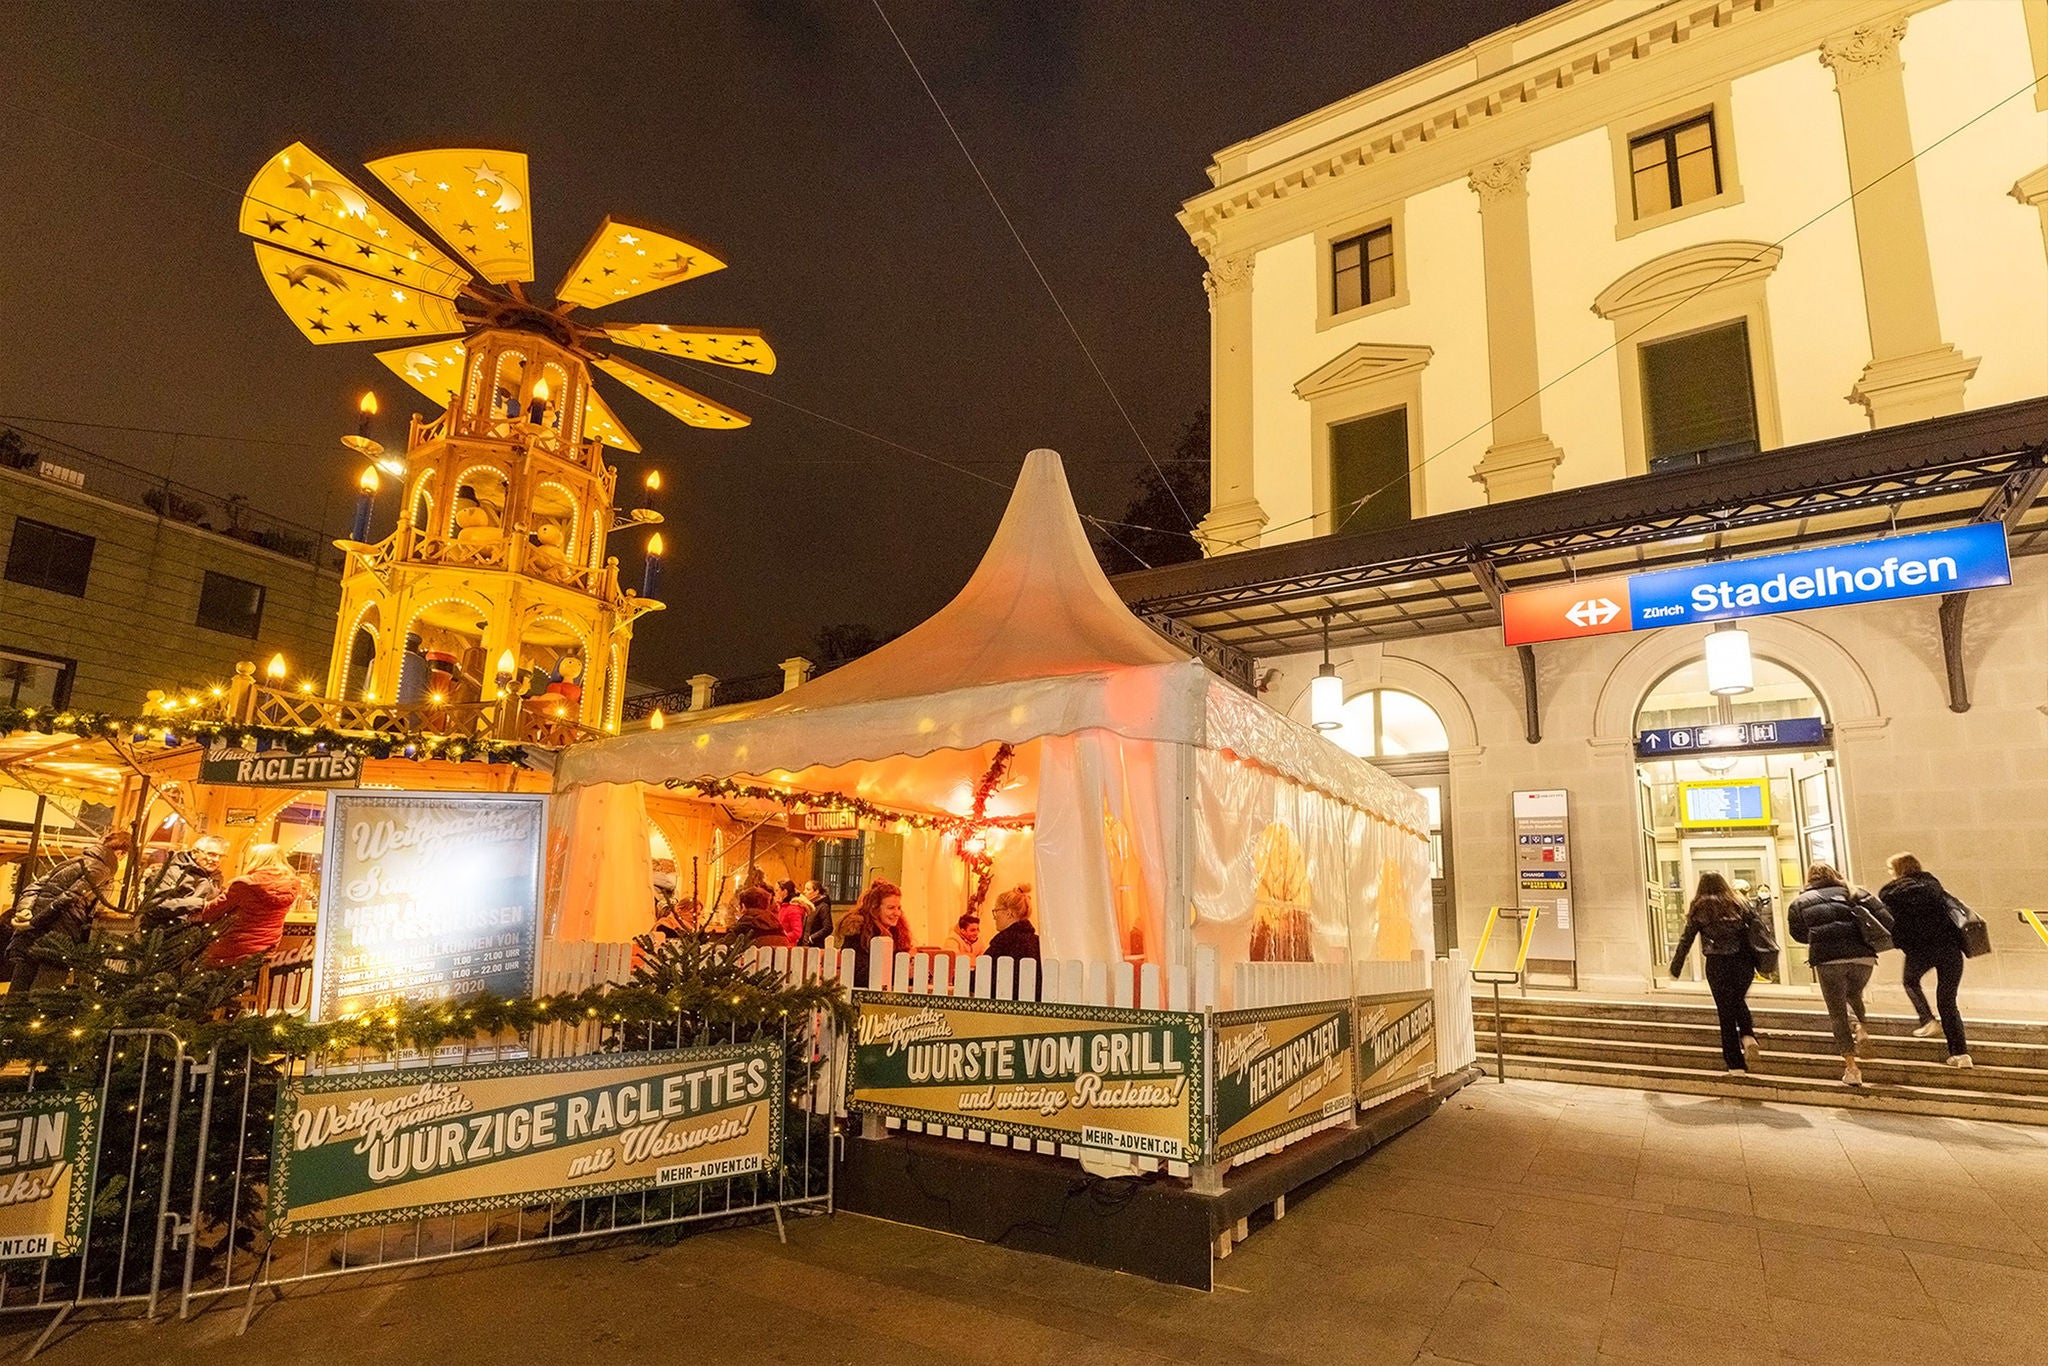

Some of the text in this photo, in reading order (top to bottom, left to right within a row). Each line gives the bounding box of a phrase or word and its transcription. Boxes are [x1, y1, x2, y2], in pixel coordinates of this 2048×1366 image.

[1643, 555, 1958, 620] Zürich Stadelhofen
[237, 755, 358, 784] RACLETTES
[453, 956, 472, 966] 11.00
[483, 951, 503, 962] 21.00
[505, 949, 520, 958] UHR
[497, 932, 520, 947] VON
[452, 969, 471, 978] 11.00
[481, 963, 503, 975] 22.00
[505, 961, 520, 971] UHR
[857, 1007, 945, 1047] Weihnachts-
[886, 1020, 953, 1057] Pyramide
[907, 1030, 1185, 1083] WÜRSTE VOM GRILL
[1249, 1017, 1340, 1109] HEREINSPAZIERT
[958, 1072, 1187, 1117] und würzige Raclettes!
[293, 1082, 460, 1150] Weihnachts-
[354, 1095, 473, 1155] Pyramide
[368, 1058, 767, 1183] WÜRZIGE RACLETTES
[568, 1104, 758, 1180] mit Weisswein!
[1085, 1128, 1178, 1155] MEHR-ADVENT.CH
[660, 1156, 759, 1183] MEHR-ADVENT.CH
